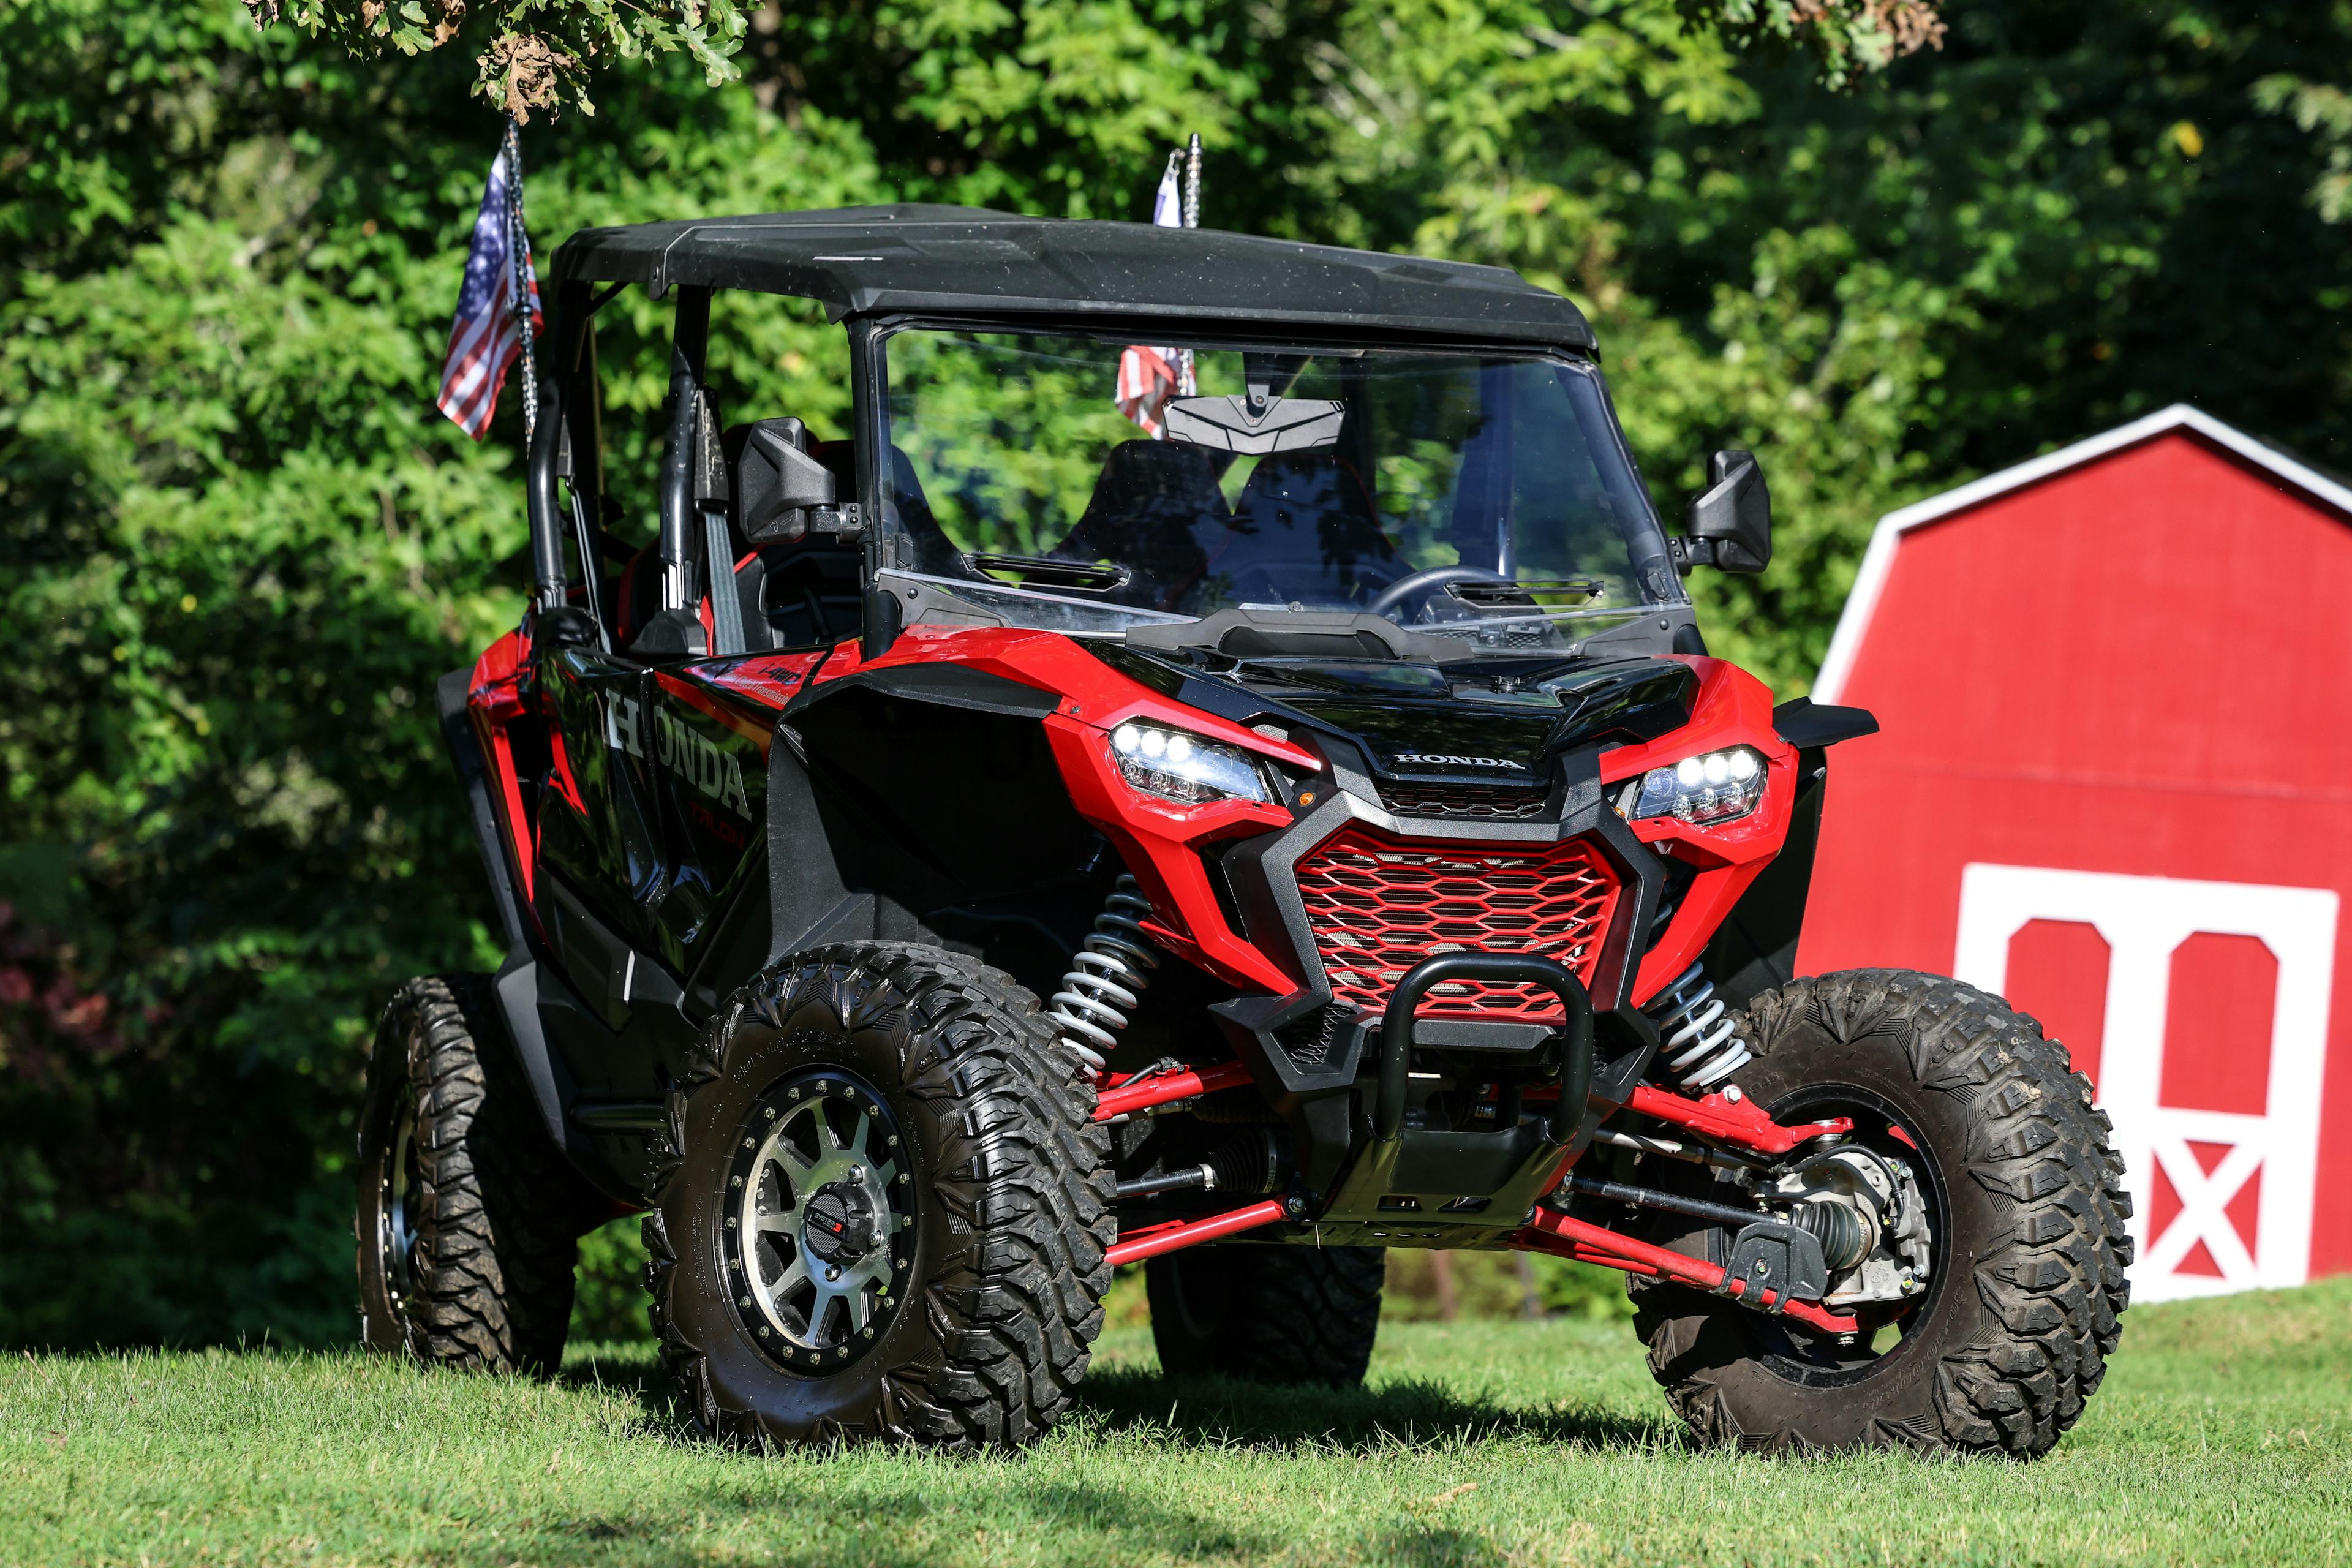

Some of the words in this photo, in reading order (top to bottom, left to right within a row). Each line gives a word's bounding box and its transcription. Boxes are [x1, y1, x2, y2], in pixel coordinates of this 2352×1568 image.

[605, 688, 752, 823] HONDA
[1394, 754, 1526, 769] HONDA
[688, 799, 745, 853] TALON
